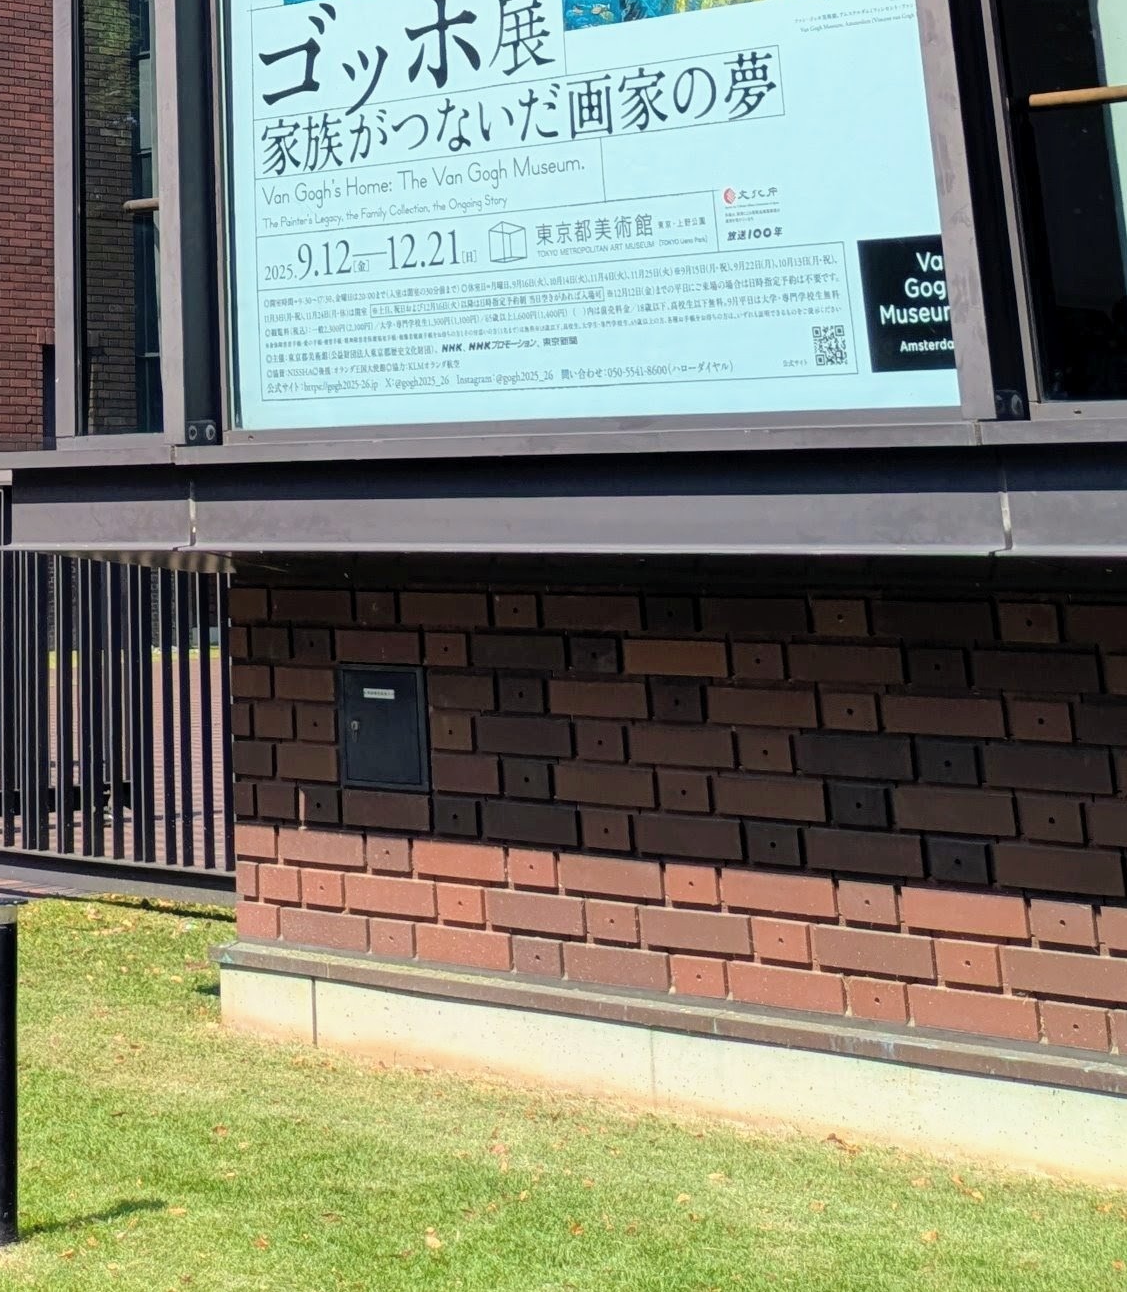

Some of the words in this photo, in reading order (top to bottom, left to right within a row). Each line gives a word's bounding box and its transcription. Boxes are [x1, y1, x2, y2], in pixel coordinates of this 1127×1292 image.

[261, 51, 776, 176] 家族がつないだ画家の夢
[262, 186, 290, 205] Van
[294, 179, 341, 208] Gogh's
[346, 176, 392, 197] Home:
[397, 170, 428, 190] The
[432, 166, 462, 186] Van
[468, 159, 508, 189] Gogh
[513, 156, 584, 177] Museum.
[262, 218, 278, 229] The
[280, 214, 312, 227] Painter's
[346, 209, 358, 220] the
[360, 207, 386, 221] Family
[389, 204, 430, 216] Collection,
[432, 201, 446, 211] the
[449, 197, 482, 213] Ongoing
[484, 194, 508, 208] Story
[536, 213, 653, 245] 東京都美術館
[727, 227, 782, 241] 放送100年
[537, 249, 558, 257] TOKYO
[560, 245, 608, 256] METROPOLITAN
[610, 243, 622, 251] ART
[625, 241, 654, 250] MUSEUM
[916, 251, 944, 273] Va
[904, 277, 946, 300] Gog
[900, 338, 954, 353] Amsterda
